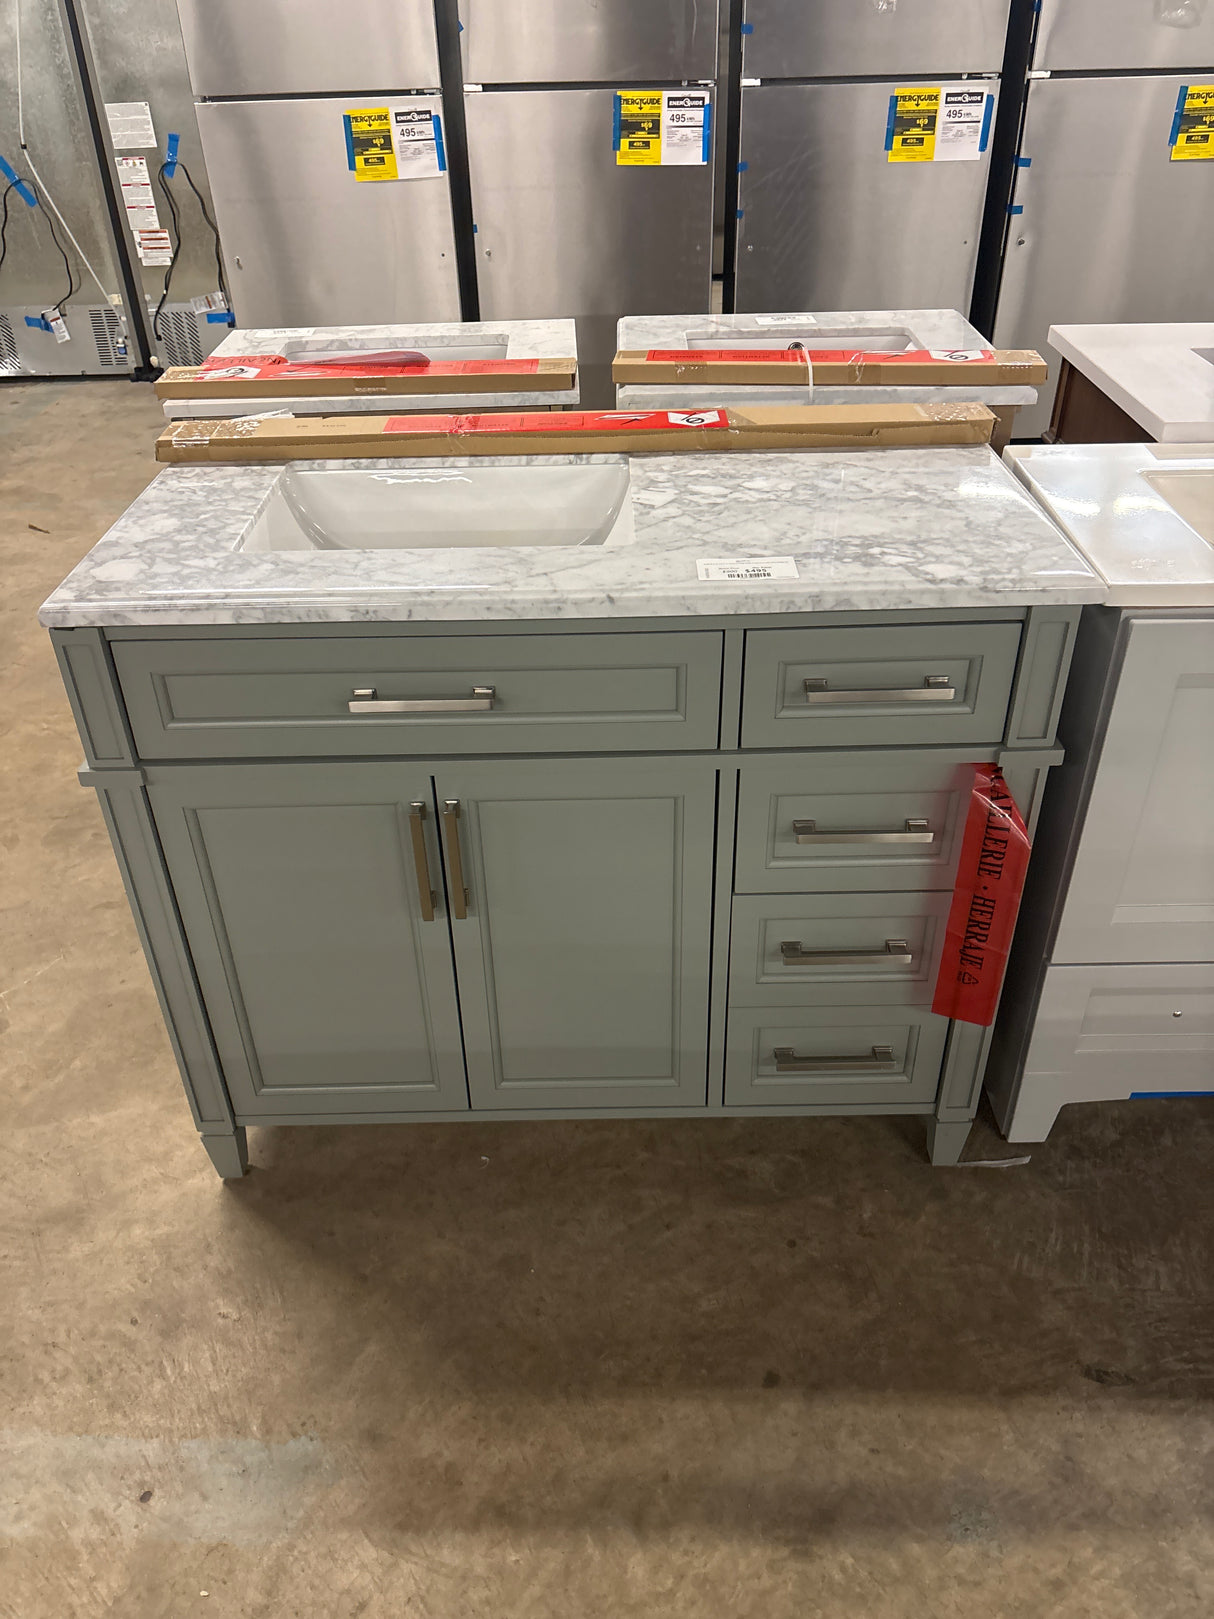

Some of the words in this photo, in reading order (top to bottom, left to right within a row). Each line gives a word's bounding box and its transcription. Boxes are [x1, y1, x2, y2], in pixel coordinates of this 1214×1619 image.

[669, 113, 686, 123] 495
[946, 109, 963, 119] 495
[400, 128, 416, 137] 495
[959, 894, 996, 970] HERRAJE
